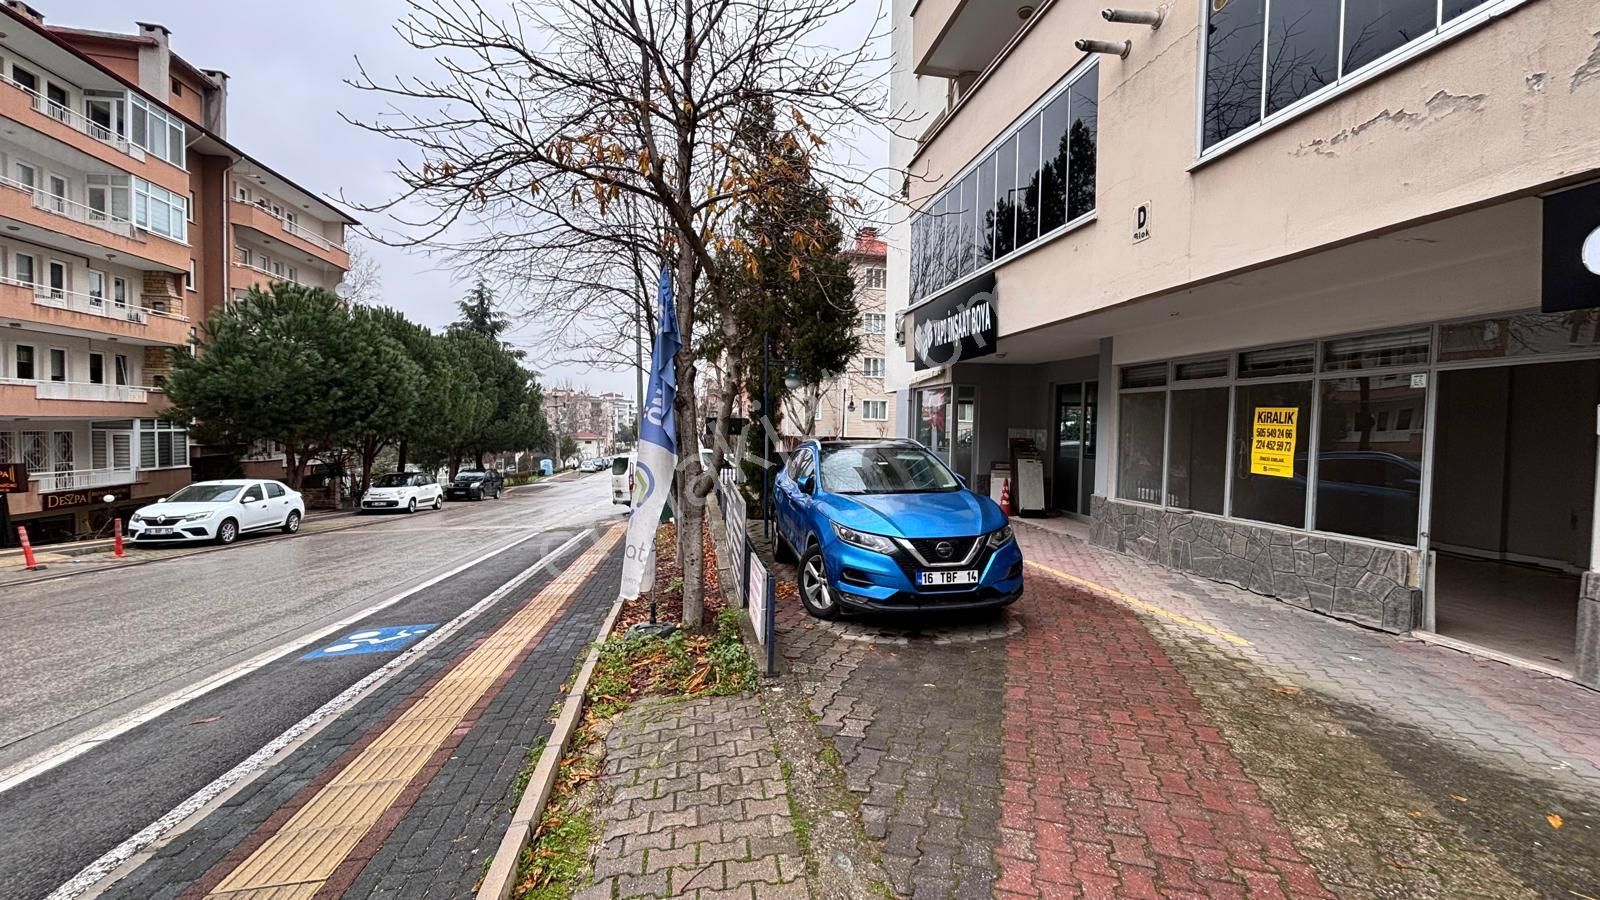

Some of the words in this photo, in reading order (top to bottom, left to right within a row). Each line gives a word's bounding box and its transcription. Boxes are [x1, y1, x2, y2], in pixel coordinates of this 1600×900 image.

[1137, 206, 1146, 229] D
[971, 302, 991, 334] BOYA
[1277, 429, 1285, 439] 24
[1285, 430, 1293, 439] 66
[1255, 440, 1266, 450] 224
[1284, 442, 1292, 452] 73
[923, 573, 934, 583] 16
[940, 572, 958, 583] TBF
[967, 571, 977, 582] 14
